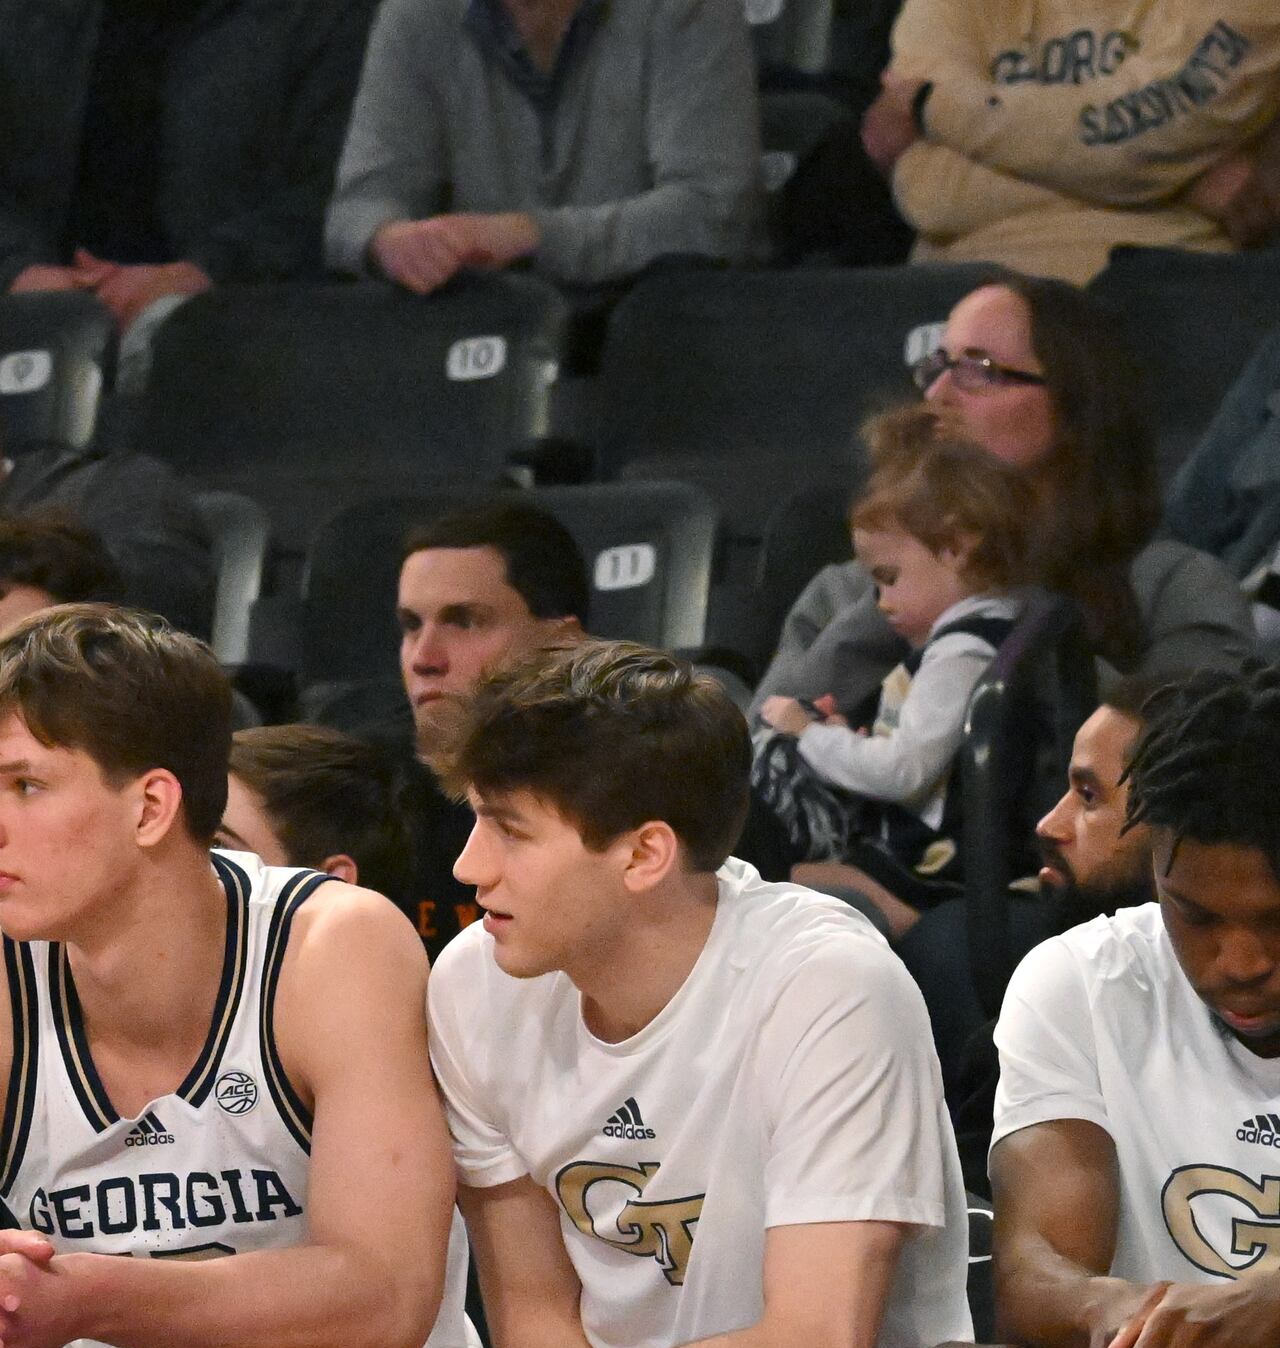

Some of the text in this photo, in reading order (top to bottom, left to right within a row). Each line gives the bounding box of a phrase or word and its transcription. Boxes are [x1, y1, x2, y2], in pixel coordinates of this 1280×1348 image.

[463, 342, 494, 371] 10
[612, 551, 639, 580] 11
[124, 1132, 175, 1147] adidas
[602, 1123, 657, 1140] adidas
[29, 1168, 303, 1239] GEORGIA
